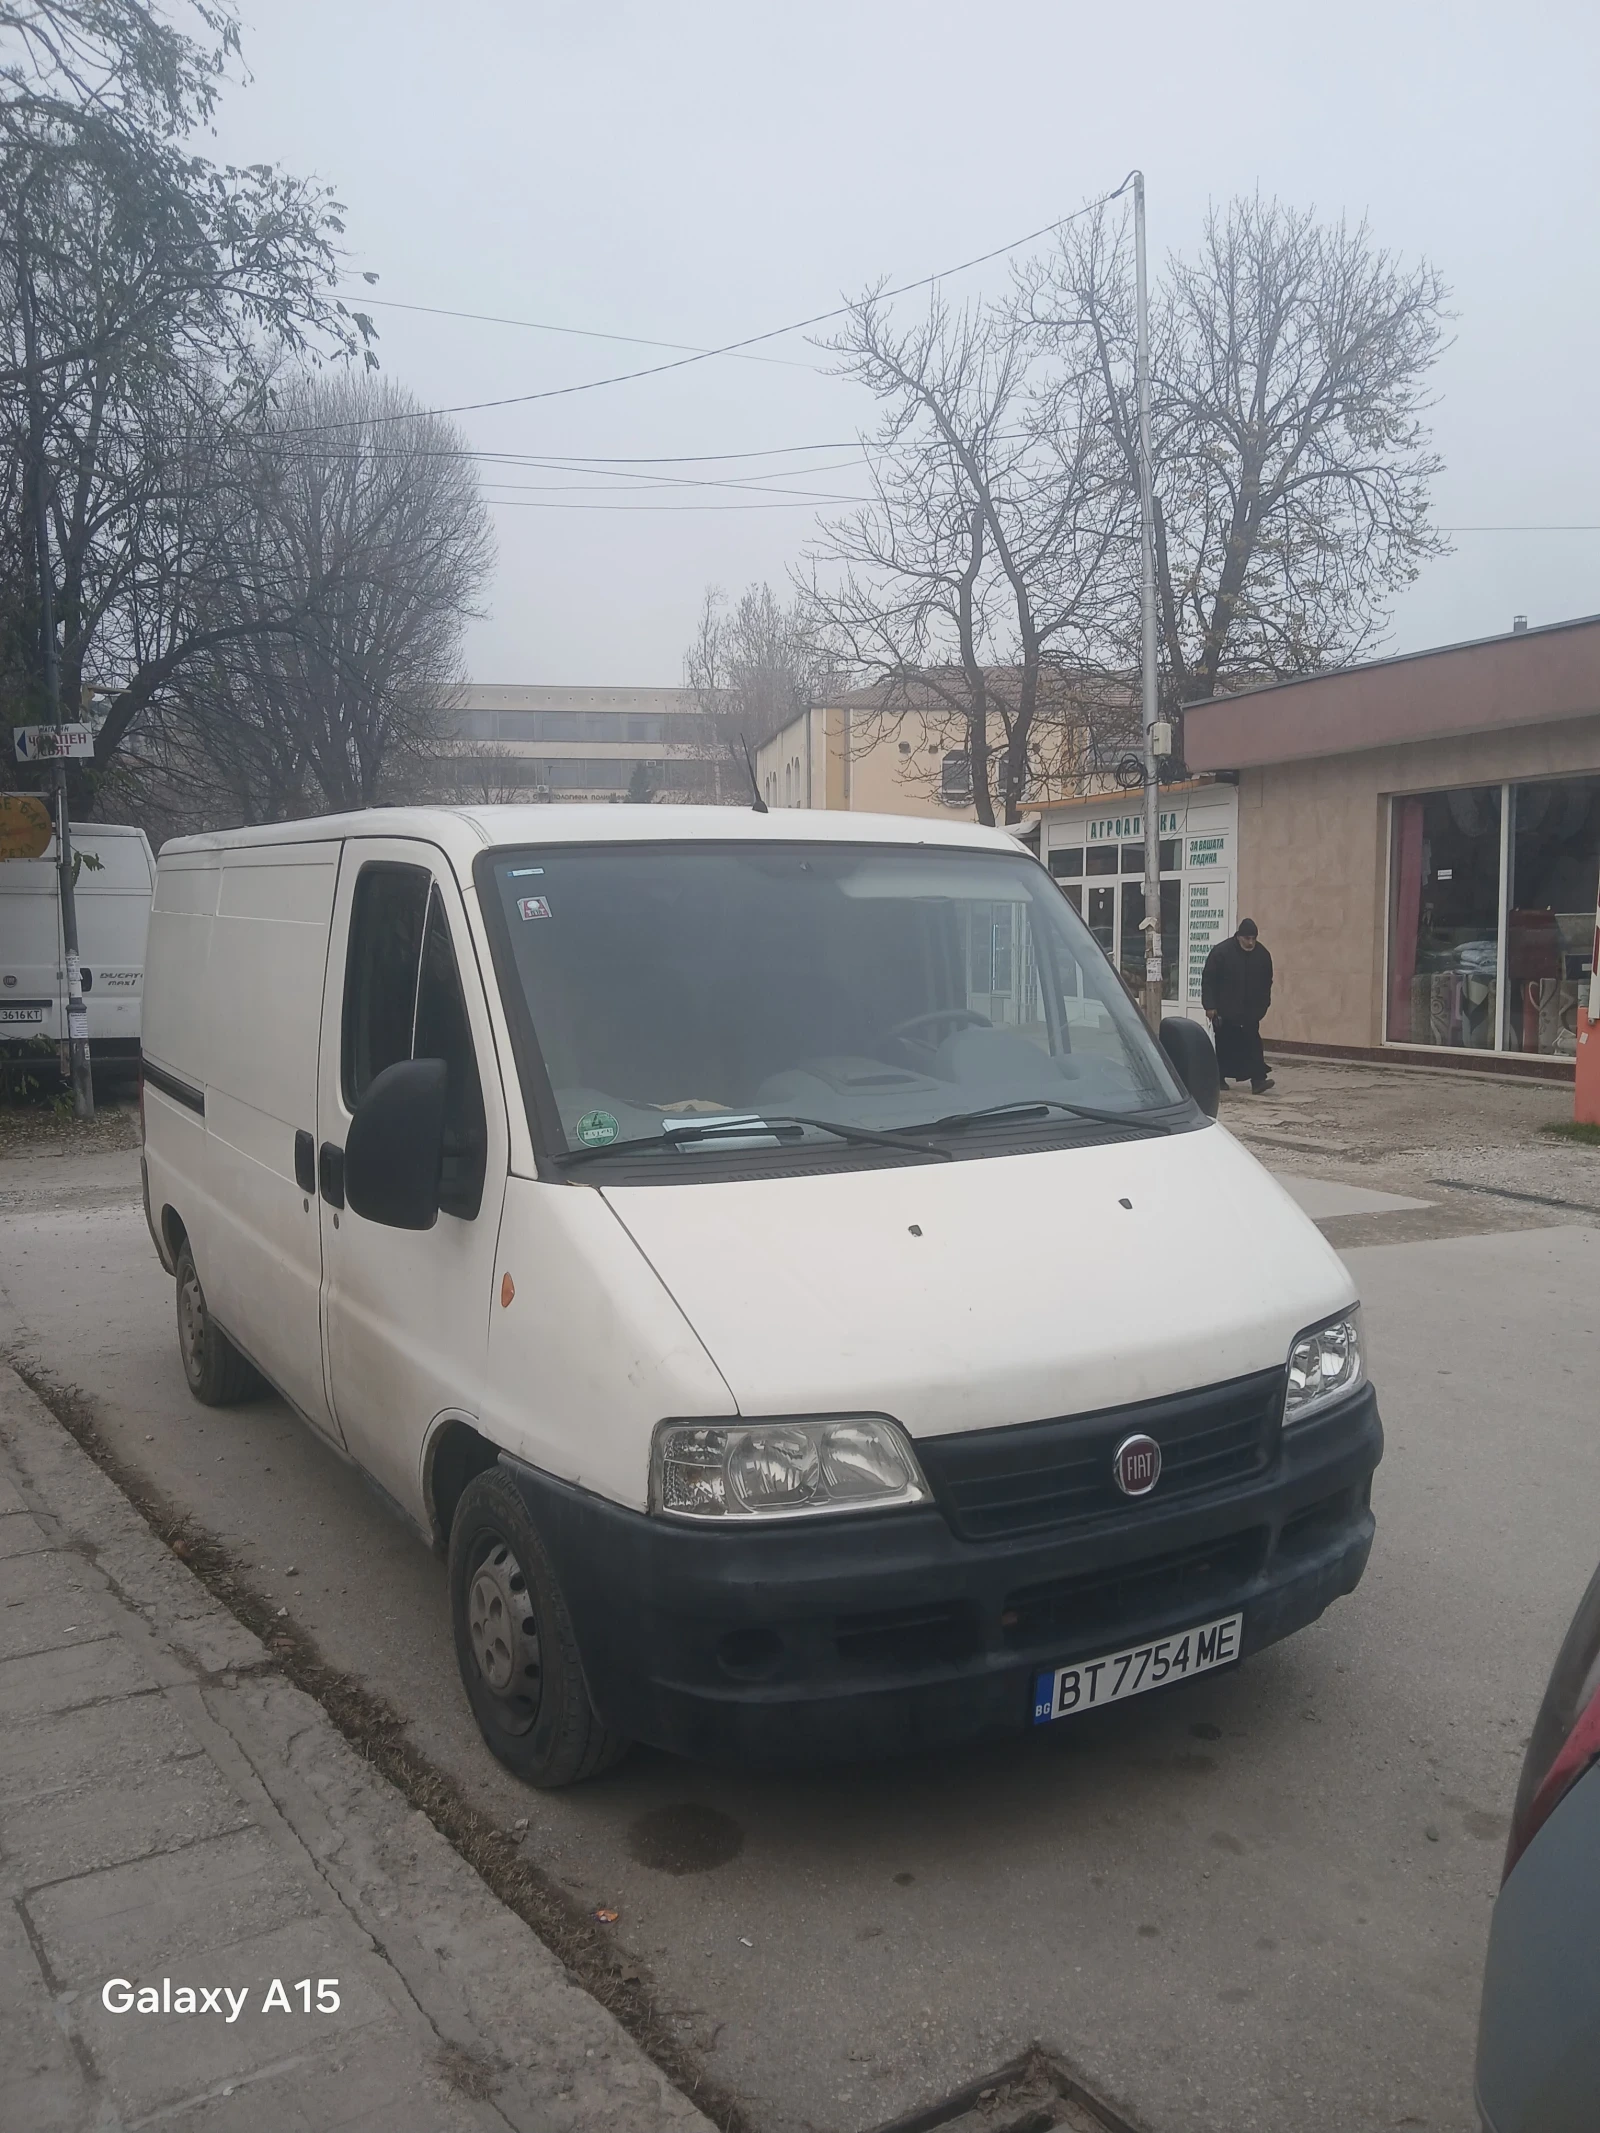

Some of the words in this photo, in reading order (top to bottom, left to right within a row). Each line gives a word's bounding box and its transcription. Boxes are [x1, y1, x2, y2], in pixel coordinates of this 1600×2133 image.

[1090, 813, 1177, 839] АГРОАПКА
[1189, 840, 1199, 852] ЗА
[1198, 838, 1225, 851] ВАШАТА
[1189, 853, 1218, 866] ГРАДИНА
[1127, 1452, 1153, 1481] FIAT
[1035, 1702, 1051, 1718] BG
